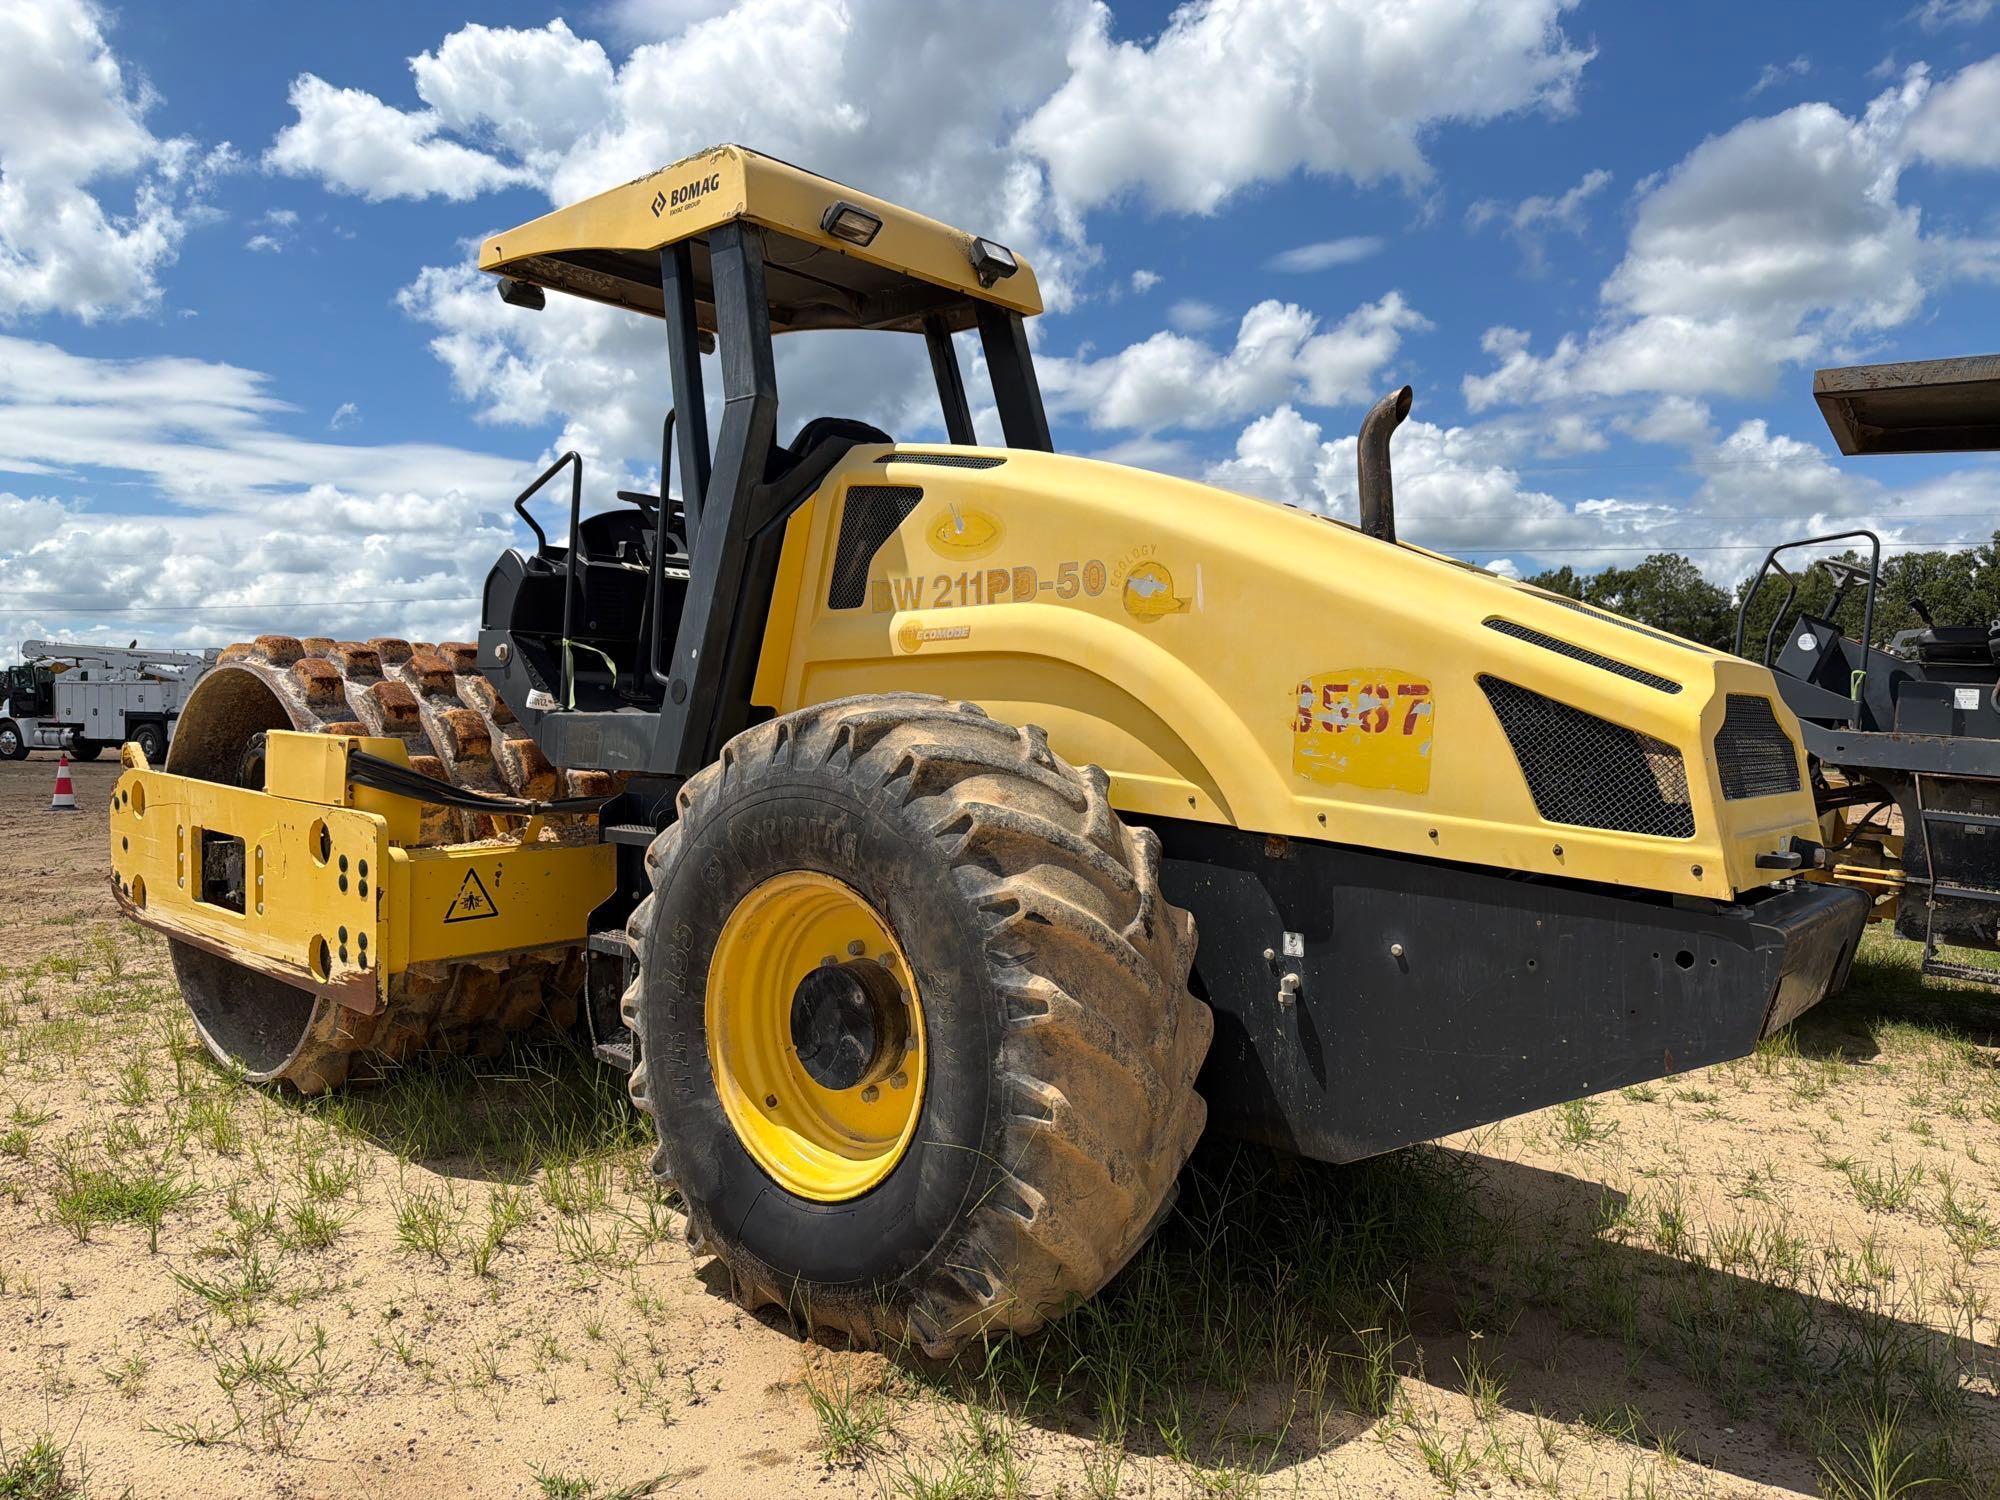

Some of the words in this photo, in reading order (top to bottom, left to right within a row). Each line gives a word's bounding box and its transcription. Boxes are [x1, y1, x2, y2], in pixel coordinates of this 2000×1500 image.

[670, 173, 720, 208] BOMAG
[684, 199, 702, 211] GROUP
[1111, 543, 1158, 589] ECOLOGY
[871, 576, 925, 613] BW
[931, 559, 1107, 610] 211PD-50
[916, 626, 970, 641] ECOMODE
